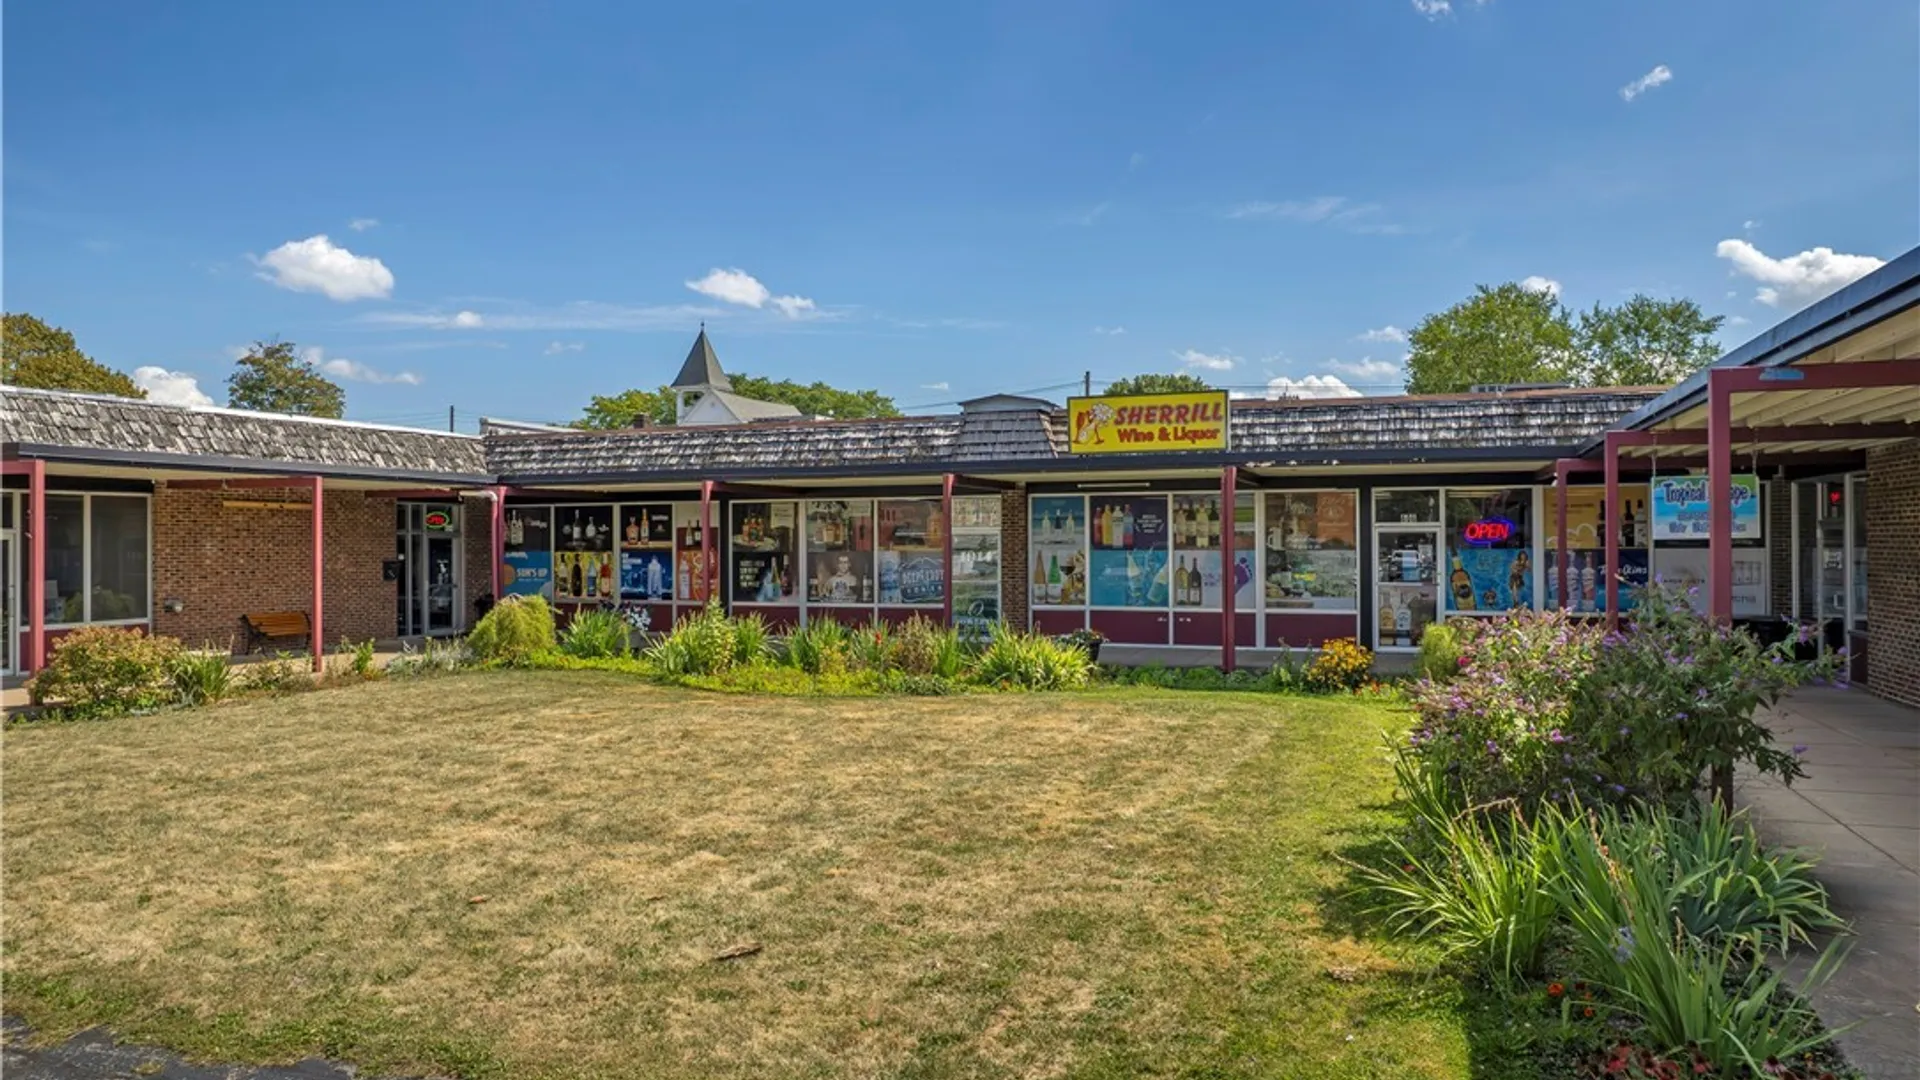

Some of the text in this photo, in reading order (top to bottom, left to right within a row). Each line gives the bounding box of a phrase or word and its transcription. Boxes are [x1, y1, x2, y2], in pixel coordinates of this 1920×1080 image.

[1114, 402, 1223, 425] SHERRILL
[1117, 427, 1221, 445] Wine & Liquor
[1663, 482, 1706, 506] Tropical
[1465, 522, 1509, 540] OPEN
